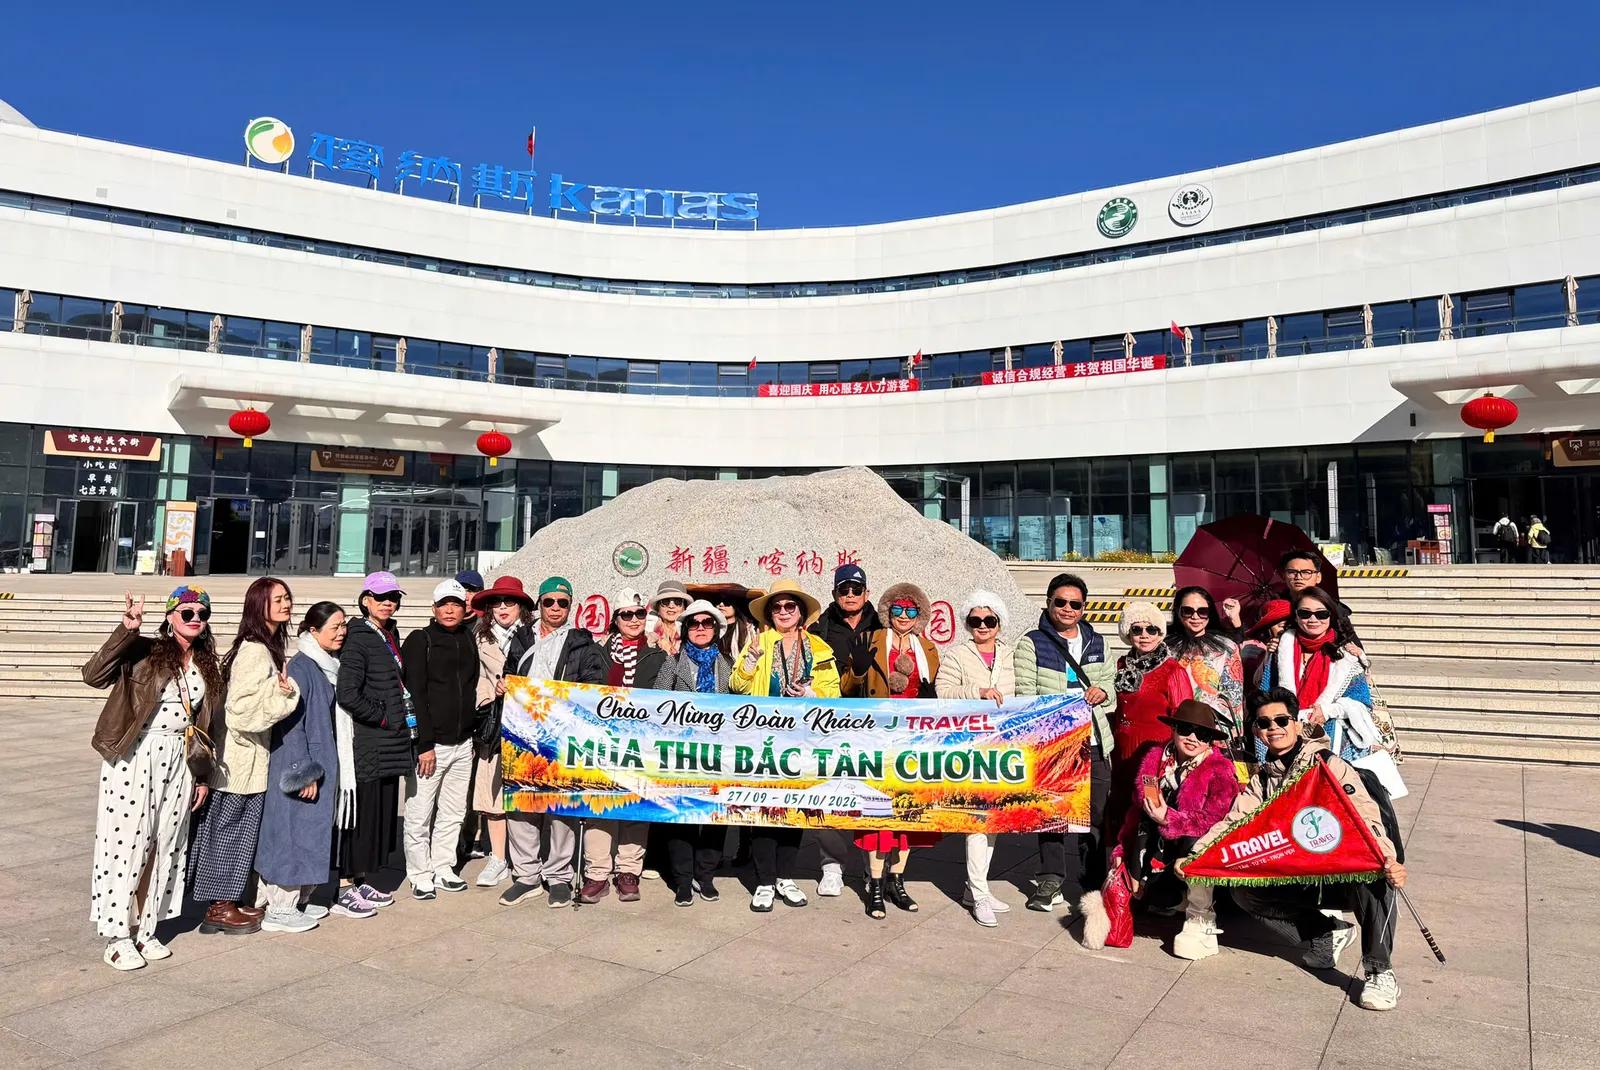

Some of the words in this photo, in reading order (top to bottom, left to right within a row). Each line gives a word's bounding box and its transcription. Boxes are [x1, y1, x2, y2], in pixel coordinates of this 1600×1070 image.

[549, 173, 760, 221] kanas
[991, 365, 1067, 384] 诚信合规经营
[1073, 355, 1155, 377] 共贺祖国华诞
[768, 383, 813, 397] 喜迎国庆
[818, 379, 910, 395] 用心服务八方游客
[67, 433, 140, 447] 喀纳斯美食街
[382, 458, 395, 468] A2
[79, 485, 119, 497] 七点开餐
[596, 696, 651, 720] Chào
[656, 699, 726, 732] Mừng
[732, 703, 797, 729] Đoàn
[803, 706, 877, 734] Khách
[884, 715, 898, 730] J
[905, 714, 997, 731] TRAVEL
[565, 729, 645, 768] MÙA
[654, 740, 723, 772] THU
[734, 736, 801, 776] BẮC
[812, 742, 883, 779] TÂN
[895, 749, 1026, 781] CƯƠNG
[1221, 847, 1229, 864] J
[1230, 829, 1290, 860] TRAVEL
